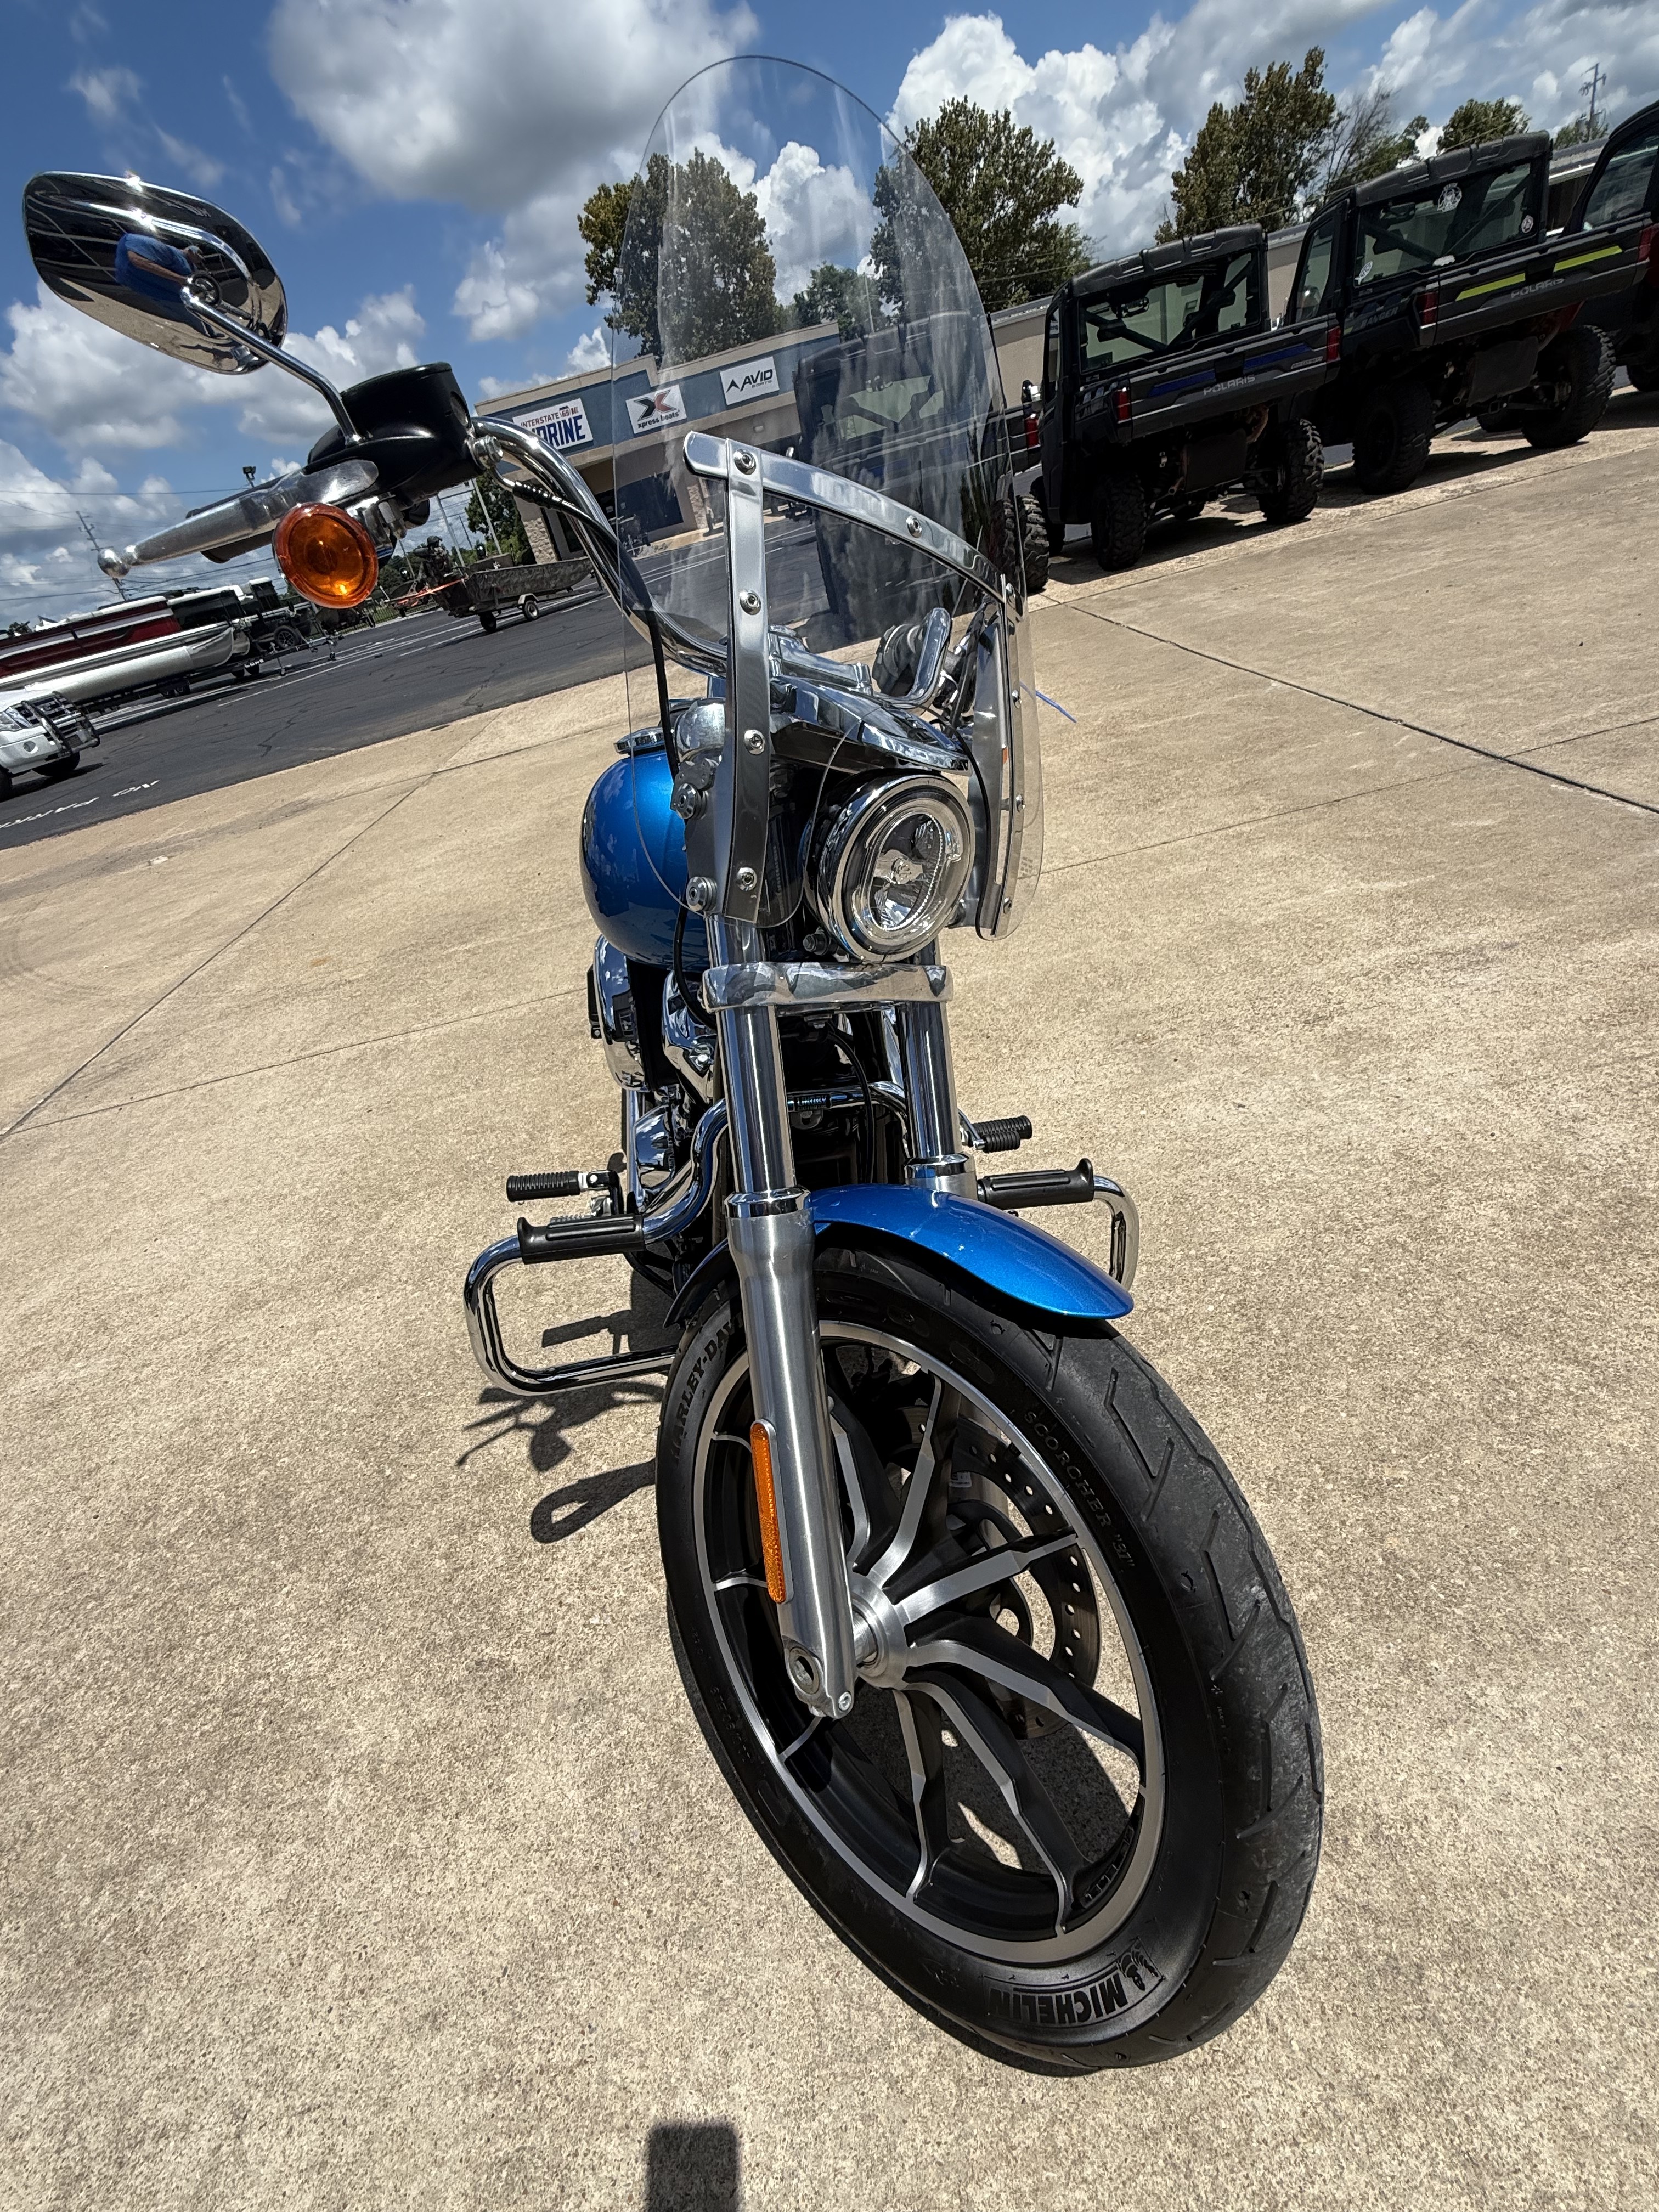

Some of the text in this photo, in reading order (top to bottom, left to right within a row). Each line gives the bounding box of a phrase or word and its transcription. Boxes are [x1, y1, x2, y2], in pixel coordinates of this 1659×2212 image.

[1511, 278, 1565, 298] POLARIS
[740, 369, 773, 392] AVID
[752, 380, 772, 388] BOATS
[1203, 375, 1256, 396] POLARIS
[520, 411, 560, 428] INTERSTATE
[637, 411, 679, 429] xpress boats
[531, 414, 586, 447] ARINE
[1024, 1410, 1113, 1528] SCORCHER
[988, 1973, 1129, 2025] MICHELIN
